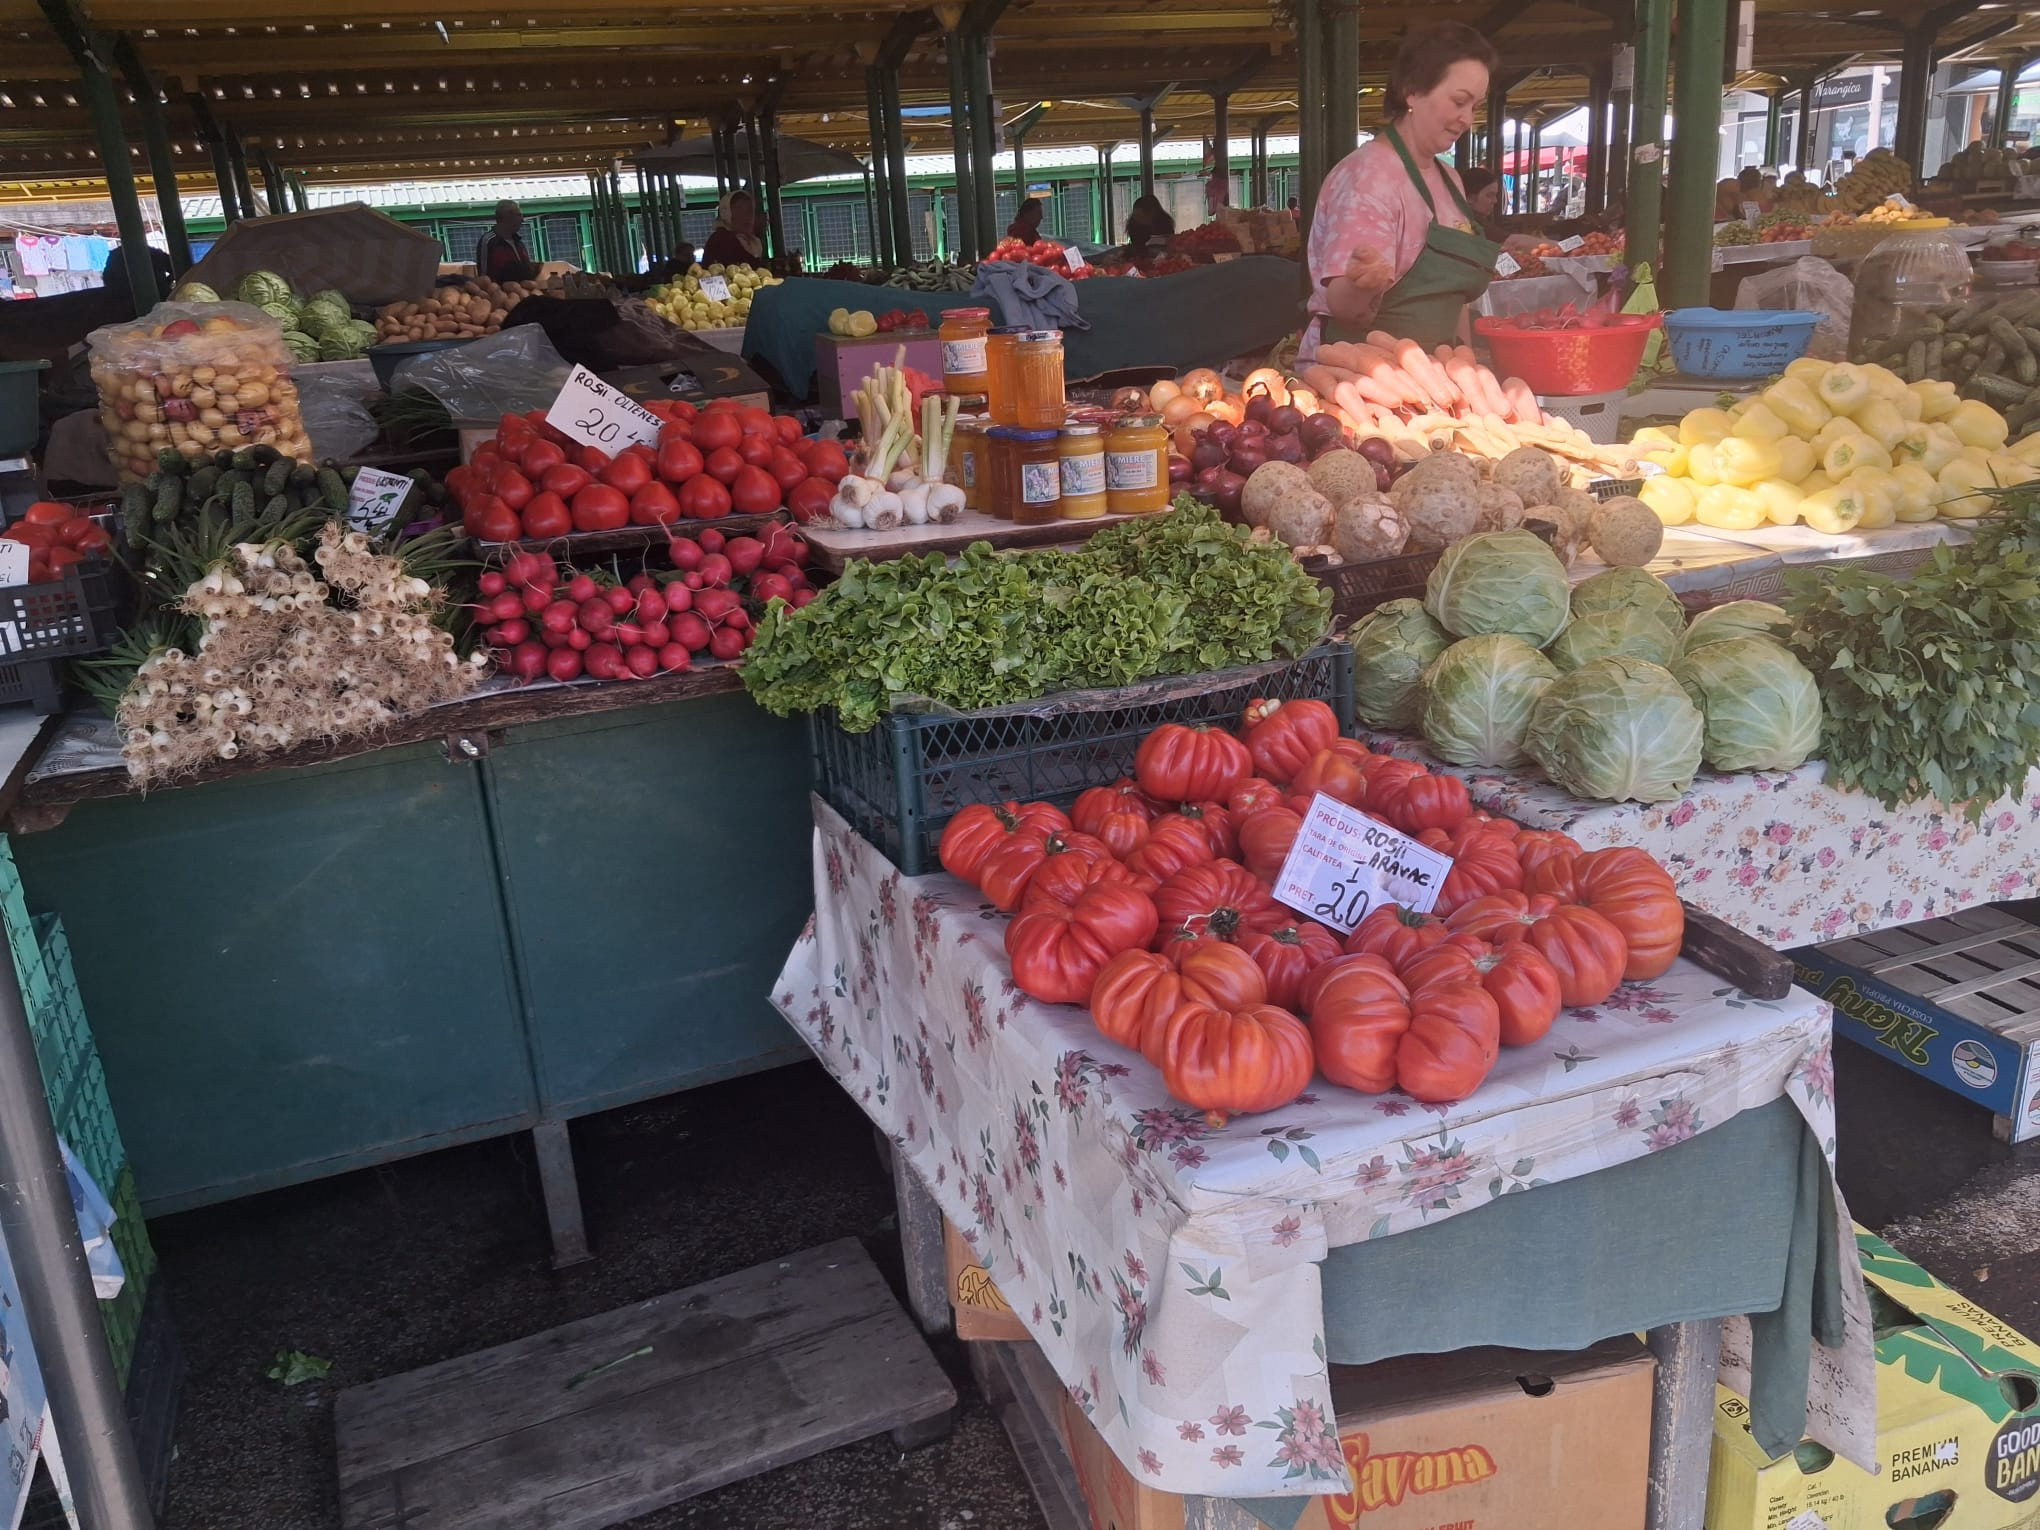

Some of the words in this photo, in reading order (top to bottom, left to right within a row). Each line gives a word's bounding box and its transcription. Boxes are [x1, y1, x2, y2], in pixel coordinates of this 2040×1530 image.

[575, 407, 621, 442] 20
[1119, 456, 1145, 464] MIERE
[1315, 810, 1361, 840] PRODUS:
[1302, 844, 1343, 870] CALITATEA
[1328, 839, 1337, 848] DE
[1287, 883, 1317, 904] PRET:
[1314, 882, 1370, 928] 20
[1891, 998, 1933, 1025] COSECHA
[1945, 1303, 2014, 1347] PREMIUM
[1957, 1301, 2026, 1347] BANANAS
[1892, 1435, 1959, 1468] PREMIM
[1997, 1422, 2040, 1459] GOOD
[1328, 1433, 1497, 1529] Savana
[1892, 1452, 1959, 1483] BANANAS
[1996, 1444, 2040, 1489] BAN
